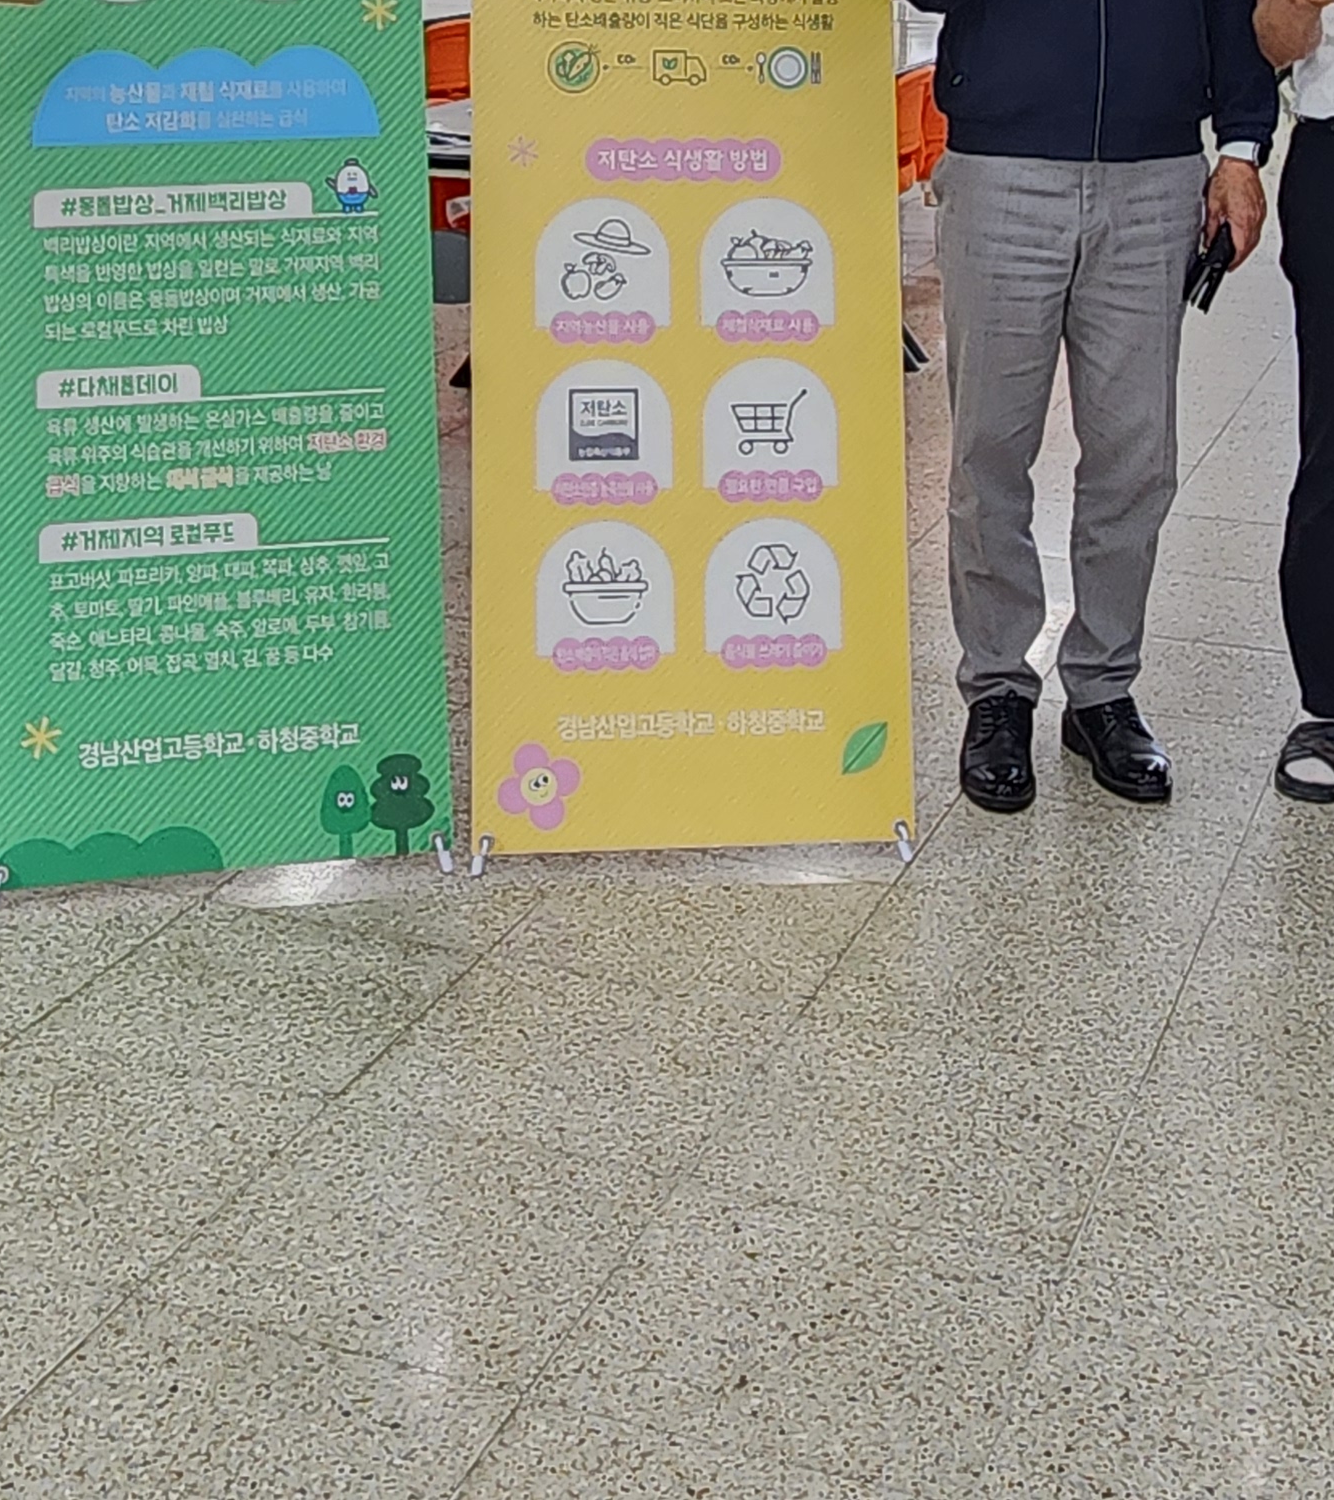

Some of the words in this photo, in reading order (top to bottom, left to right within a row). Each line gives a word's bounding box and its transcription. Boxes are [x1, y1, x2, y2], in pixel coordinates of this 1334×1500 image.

[533, 11, 561, 28] 하는
[566, 11, 650, 29] 탄소배출량이
[654, 12, 682, 29] 적은
[687, 13, 727, 30] 식단을
[733, 14, 788, 30] 구성하는
[792, 14, 834, 30] 식생활
[106, 112, 141, 133] 탄소
[278, 108, 308, 127] 급식
[598, 149, 658, 171] 저탄소
[664, 149, 724, 171] 식생활
[730, 149, 767, 172] 방법
[145, 231, 207, 251] 지역에서
[213, 230, 275, 250] 생산되는
[281, 227, 341, 246] 식재료와
[347, 225, 378, 244] 지역
[95, 262, 143, 282] 반영한
[146, 259, 193, 280] 밥상을
[284, 254, 344, 274] 거제지역
[44, 291, 91, 313] 밥상의
[97, 290, 144, 311] 이름은
[246, 284, 307, 303] 거제에서
[45, 322, 76, 342] 되는
[162, 317, 193, 336] 차린
[198, 315, 228, 335] 밥상
[137, 412, 199, 434] 발생하는
[206, 408, 267, 429] 온실가스
[580, 400, 627, 417] 저탄소
[82, 443, 127, 463] 위주의
[198, 437, 254, 457] 개선하기
[259, 434, 303, 454] 위하여
[98, 471, 162, 493] 지향하는
[254, 463, 314, 484] 제공하는
[61, 525, 164, 551] #거제지역
[170, 522, 234, 546] 로컬푸드
[373, 552, 389, 570] 고
[303, 643, 334, 663] 다수
[557, 710, 715, 741] 경남산업고등학교
[726, 708, 827, 736] 하청중학교
[78, 731, 246, 769] 경남산업고등학교
[257, 722, 361, 754] 하청중학교
